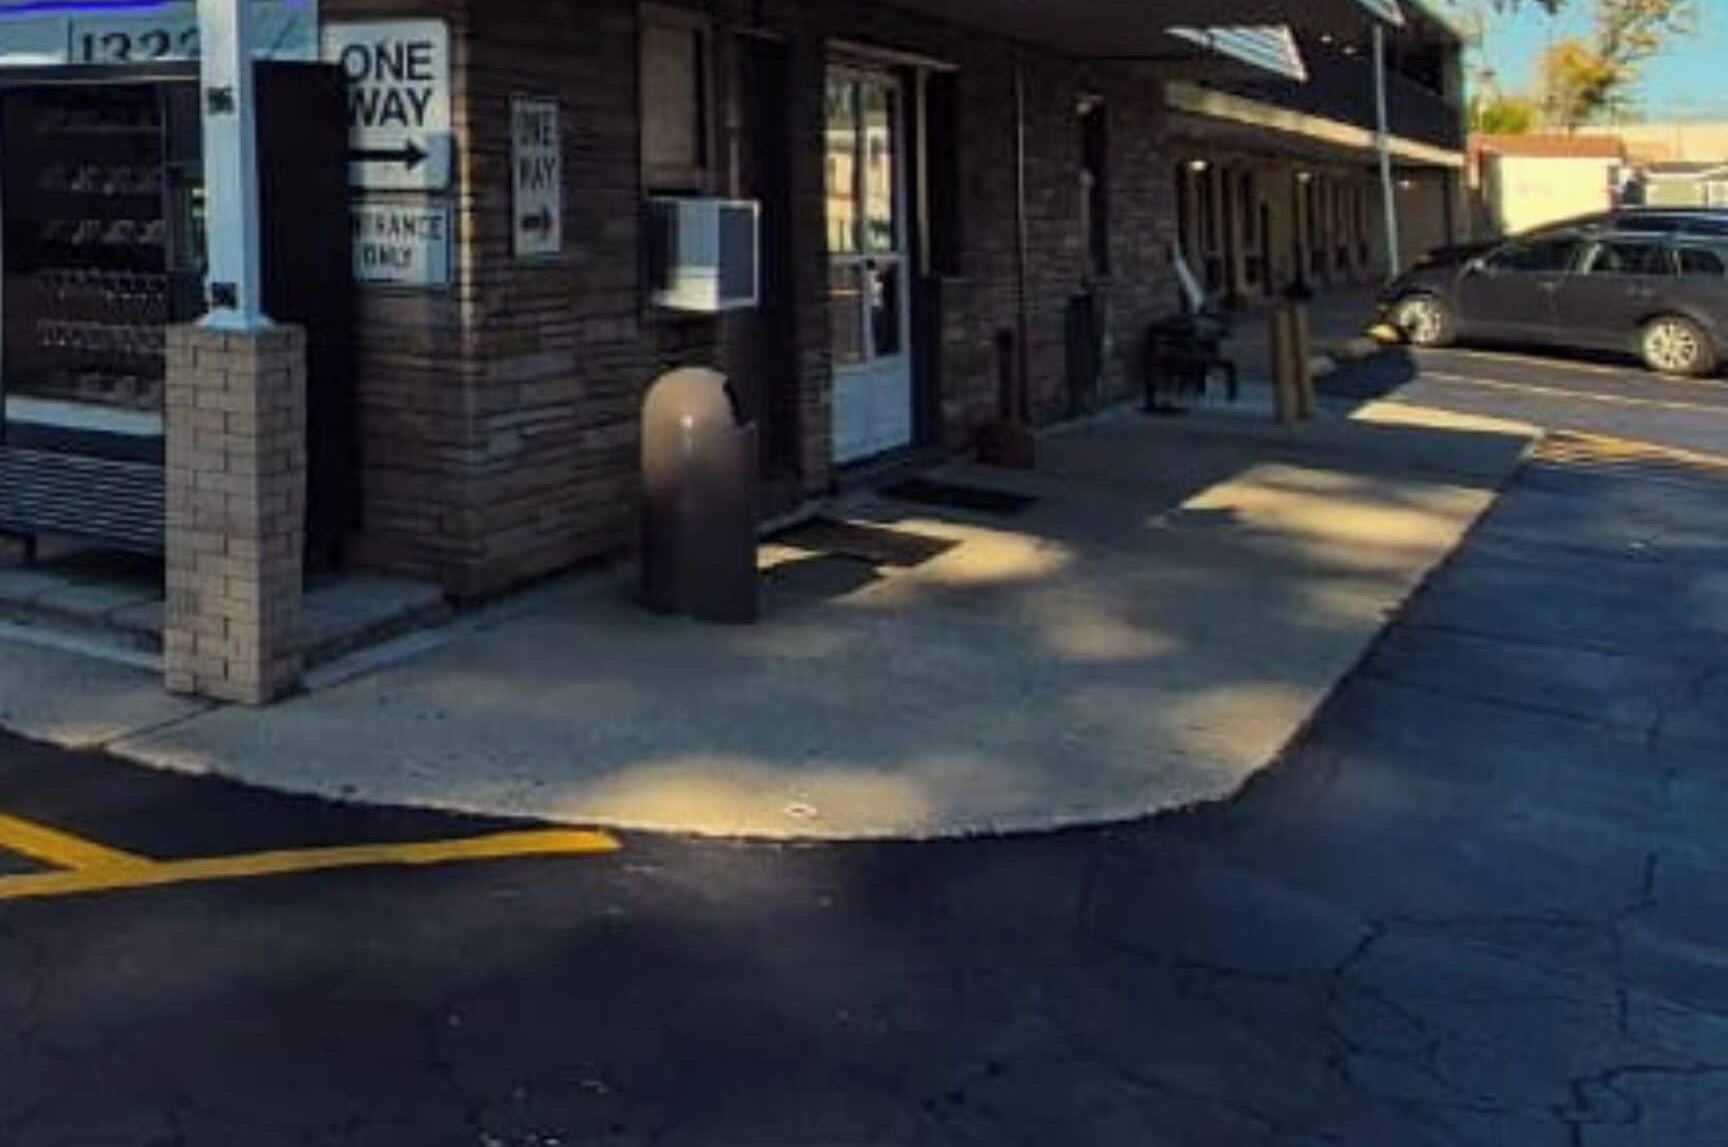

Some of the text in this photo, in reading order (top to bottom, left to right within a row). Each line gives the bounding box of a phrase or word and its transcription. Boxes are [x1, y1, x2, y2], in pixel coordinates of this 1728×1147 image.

[341, 40, 436, 84] ONE
[351, 86, 433, 128] WAY
[518, 110, 554, 148] ONE
[519, 156, 557, 190] WAY
[362, 243, 413, 268] ONLY
